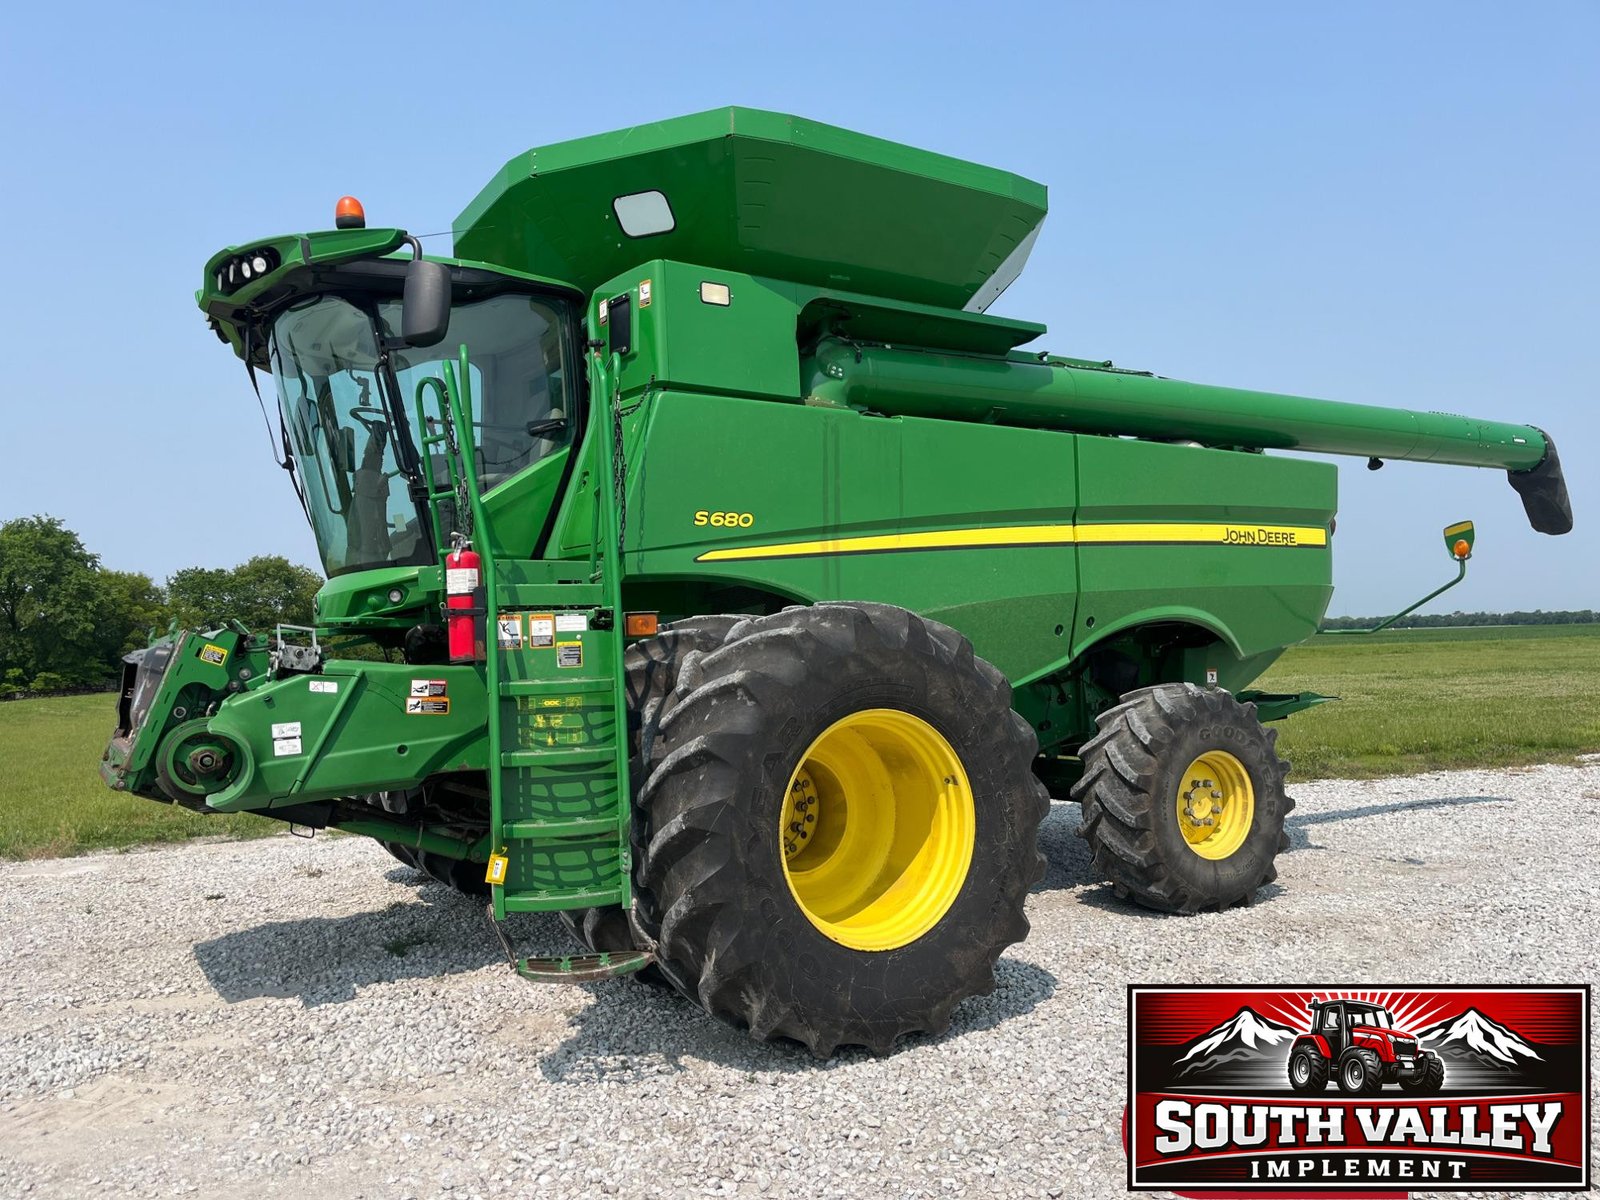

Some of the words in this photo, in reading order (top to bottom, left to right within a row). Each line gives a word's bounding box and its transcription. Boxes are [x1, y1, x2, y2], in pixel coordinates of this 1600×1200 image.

[694, 510, 754, 528] S680
[1222, 527, 1255, 542] JOHN
[1257, 529, 1296, 543] DEERE
